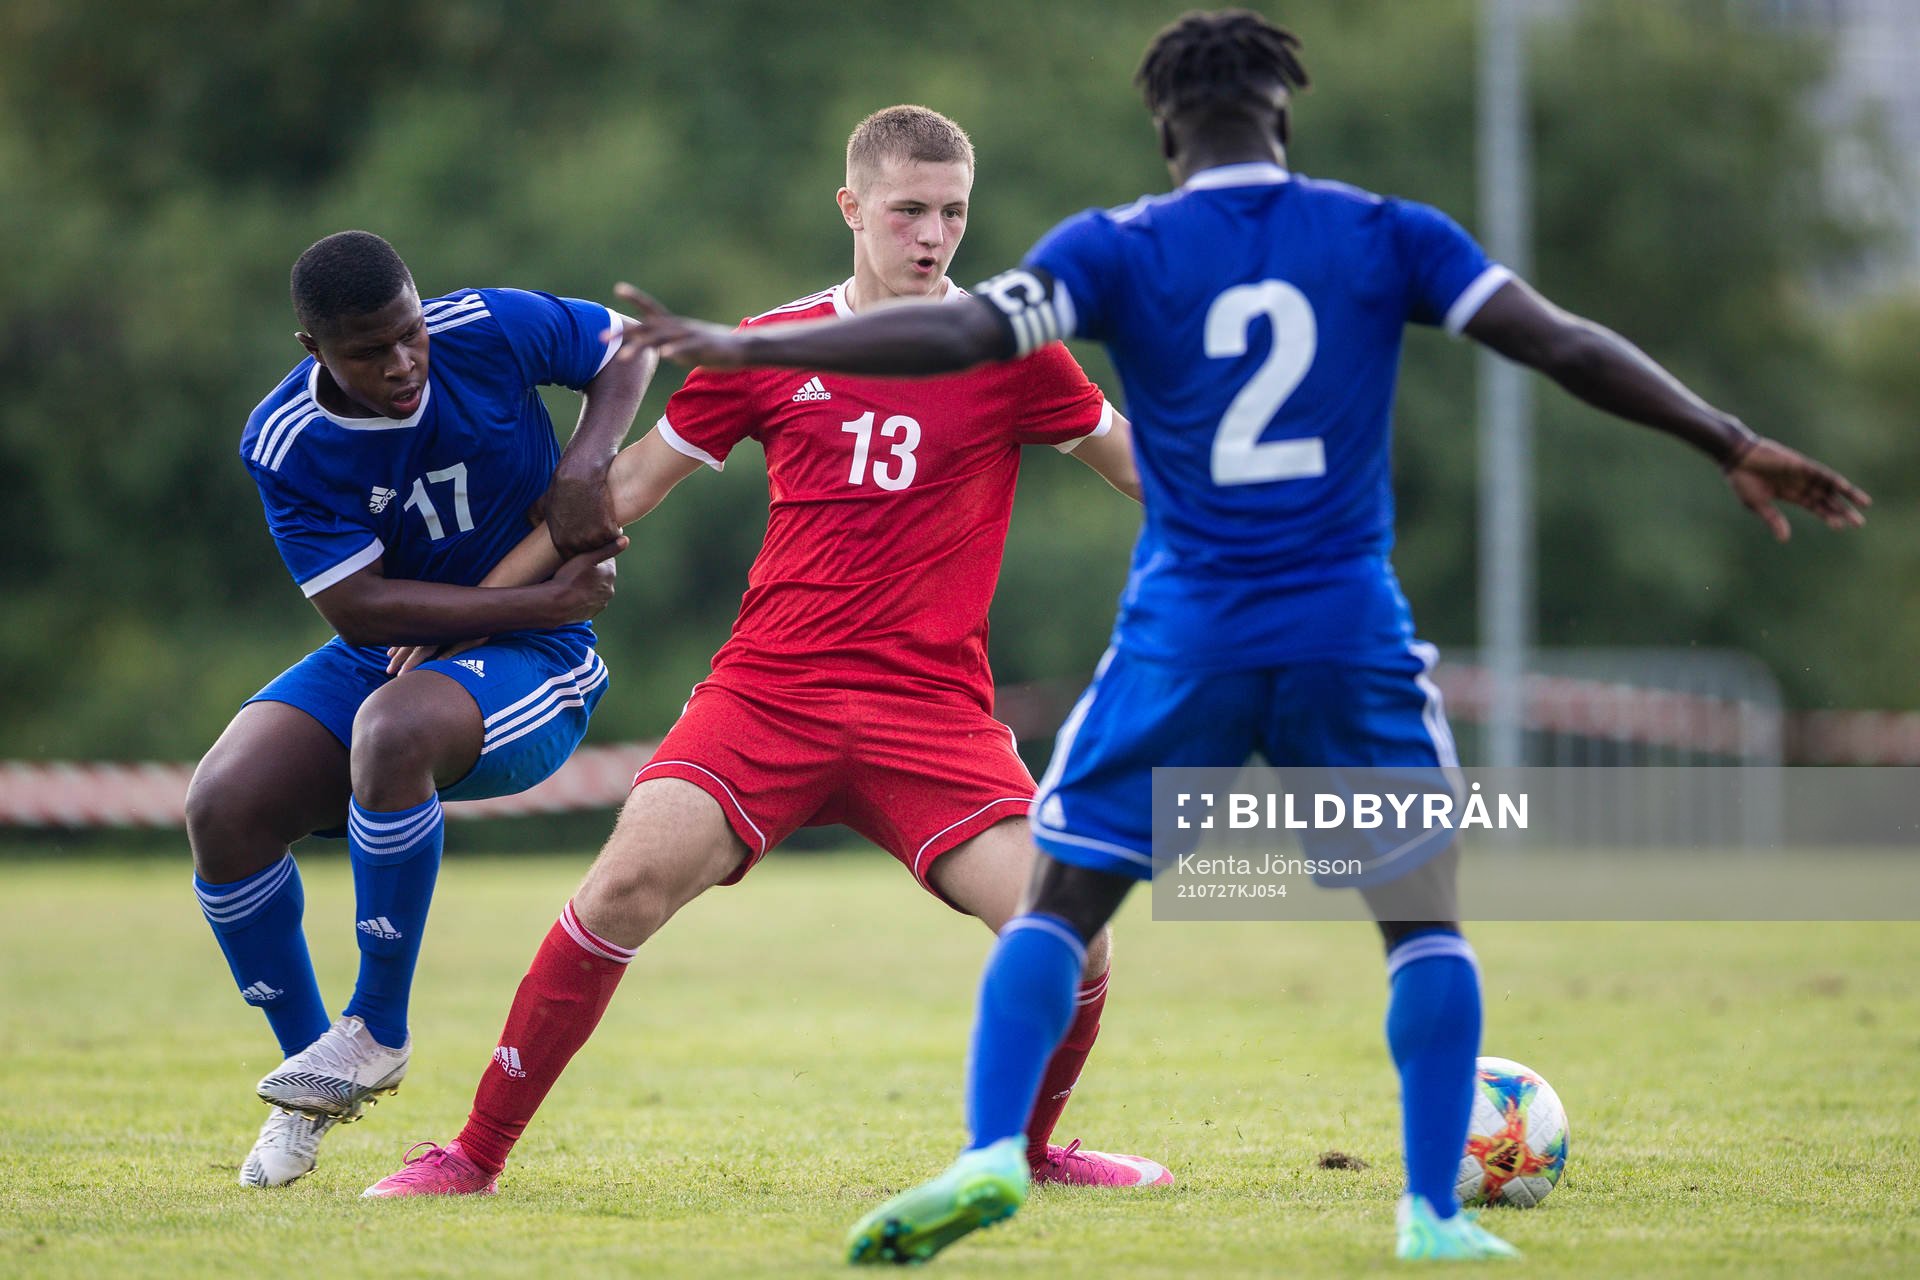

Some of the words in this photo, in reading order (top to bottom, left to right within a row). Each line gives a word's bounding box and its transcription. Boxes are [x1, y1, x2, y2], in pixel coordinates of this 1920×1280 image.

[792, 391, 832, 402] adidas
[1203, 278, 1327, 487] 2
[841, 411, 922, 491] 13
[370, 489, 397, 514] adidas
[403, 461, 475, 541] 17
